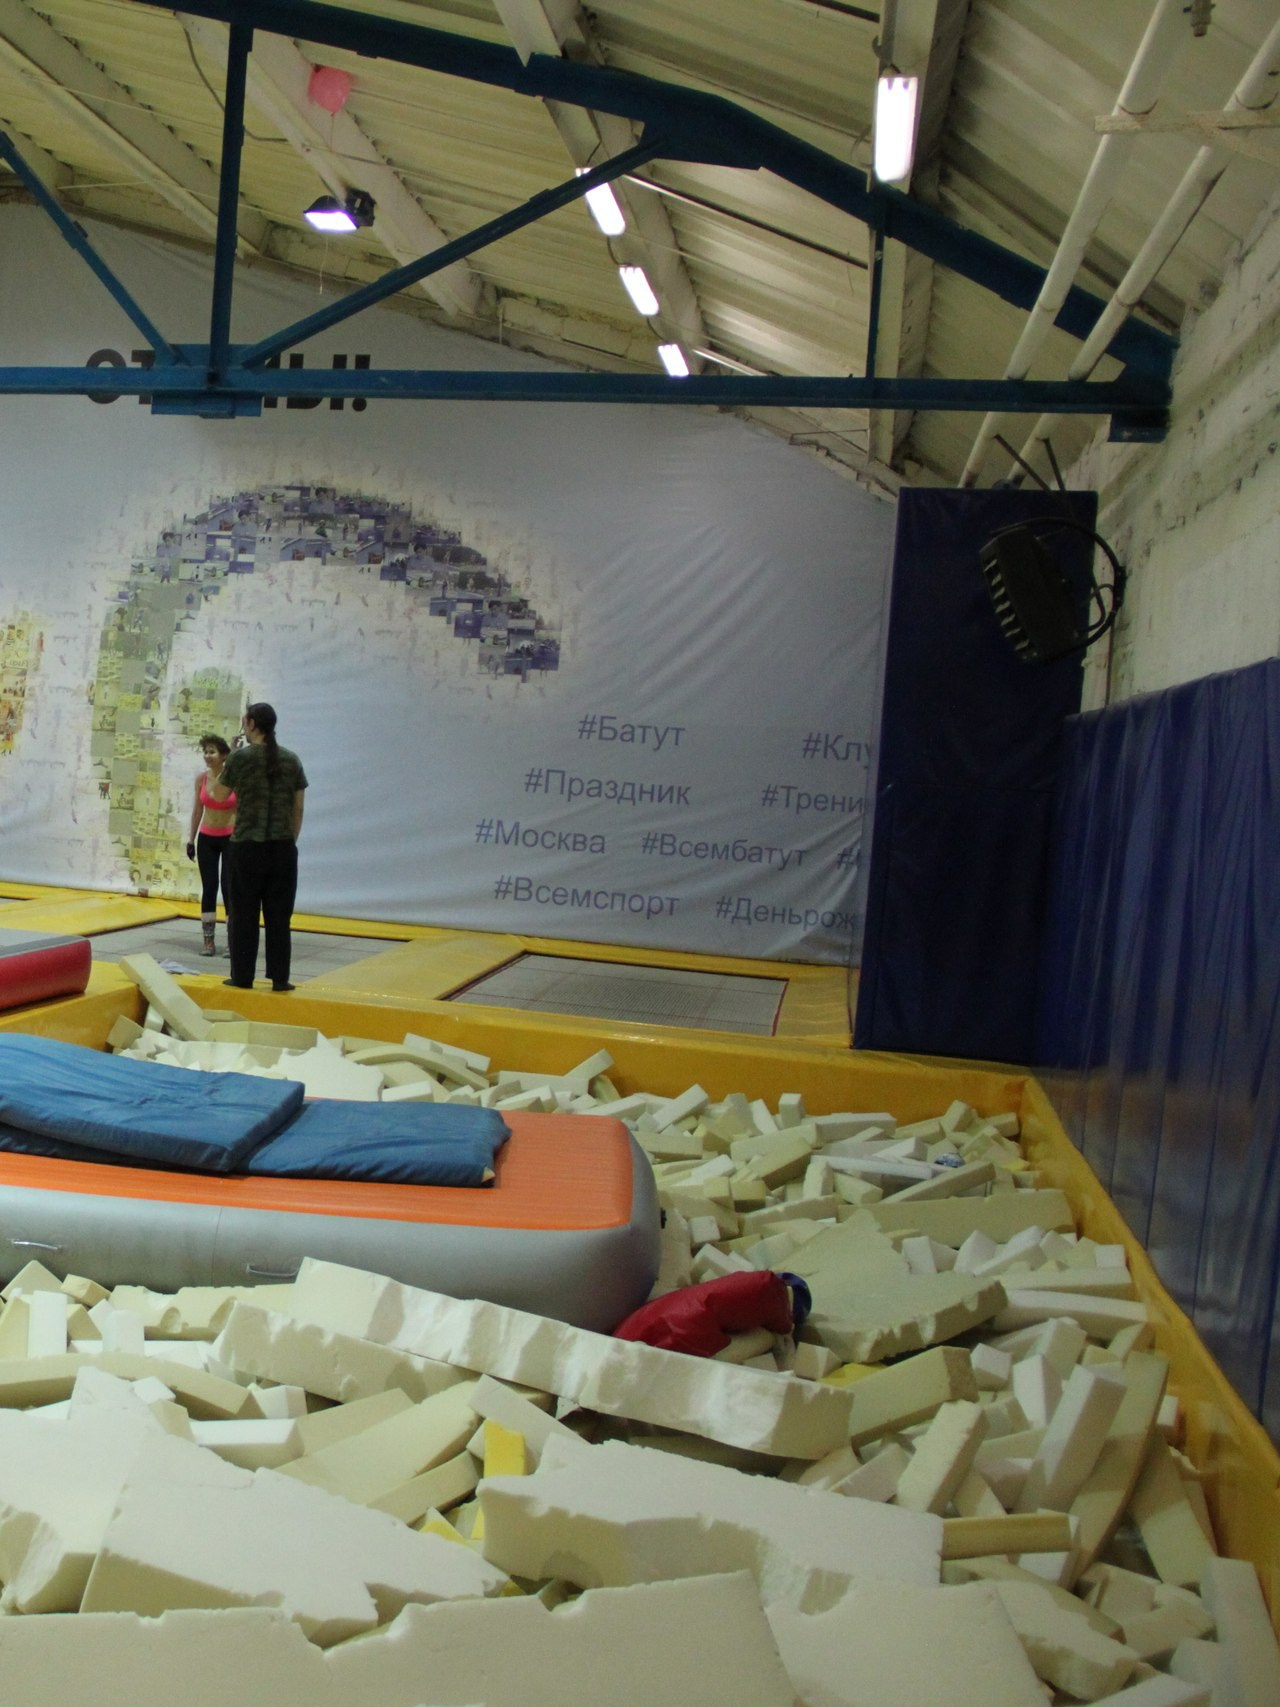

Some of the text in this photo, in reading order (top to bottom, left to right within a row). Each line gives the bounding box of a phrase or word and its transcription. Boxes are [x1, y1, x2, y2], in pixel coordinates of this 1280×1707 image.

[578, 713, 686, 751] #Батут
[524, 767, 864, 815] #Праздник #Трени
[475, 818, 606, 854] #Москва
[642, 832, 808, 871] #Всембатут
[494, 874, 680, 919] #Всемспорт
